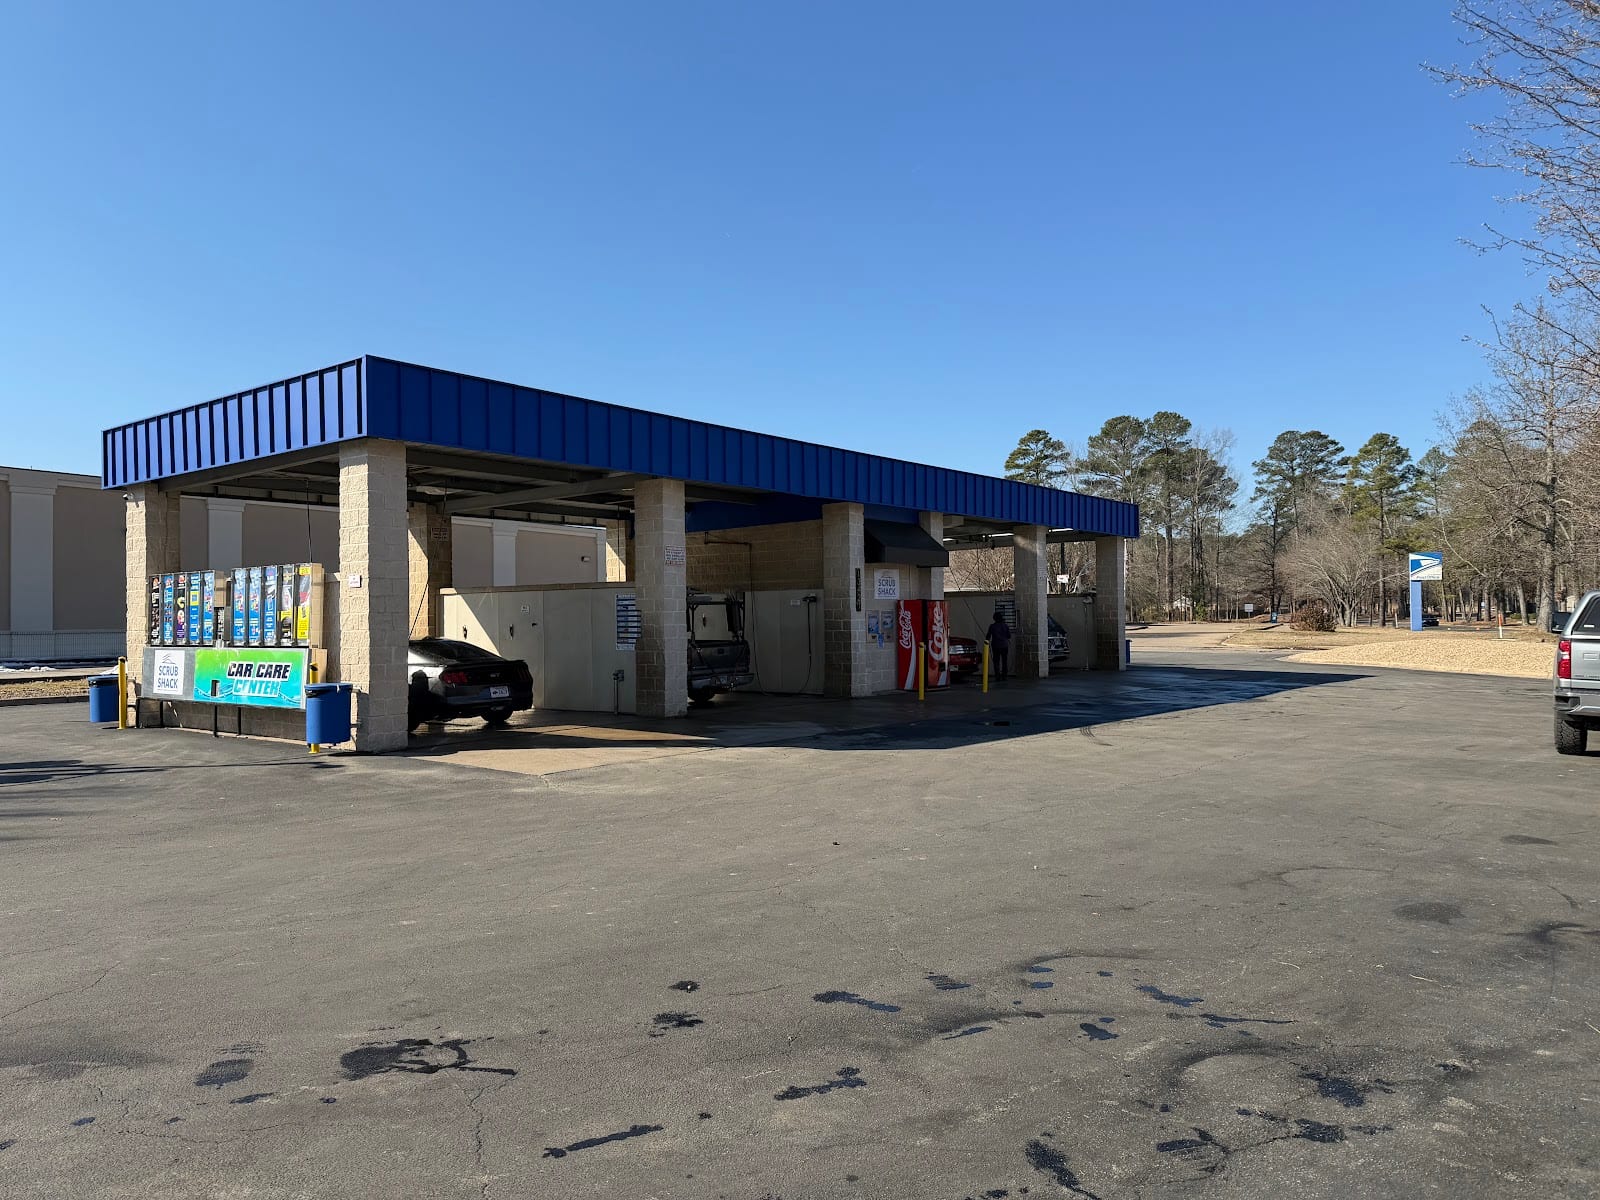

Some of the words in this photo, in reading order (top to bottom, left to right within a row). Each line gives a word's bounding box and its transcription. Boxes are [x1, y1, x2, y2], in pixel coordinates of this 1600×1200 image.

[878, 579, 896, 587] SCRUB
[878, 587, 896, 596] SHACK
[929, 607, 944, 661] Coke
[158, 665, 179, 676] SCRUB
[227, 663, 254, 678] CAR
[256, 663, 291, 679] CARE
[157, 678, 178, 689] SHACK
[233, 680, 280, 695] CENTER
